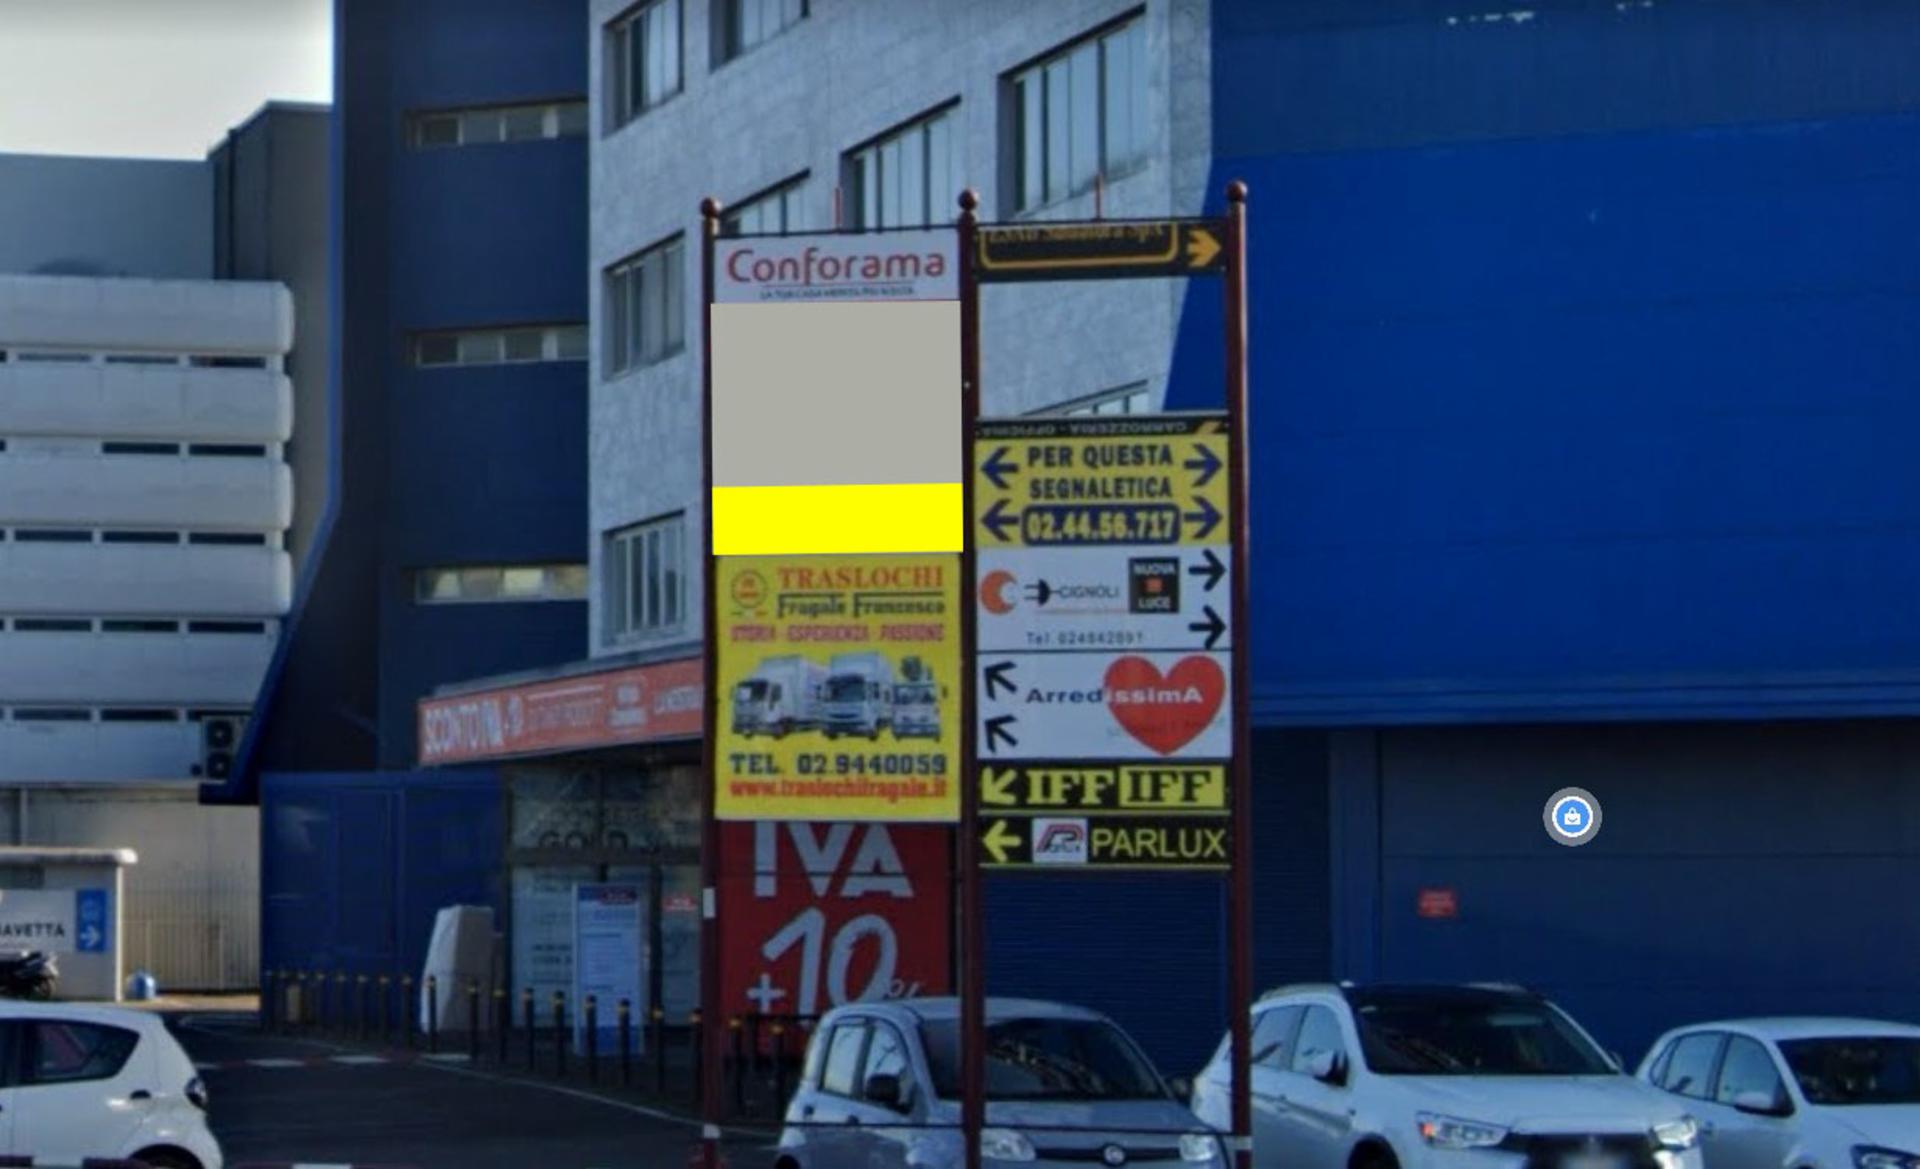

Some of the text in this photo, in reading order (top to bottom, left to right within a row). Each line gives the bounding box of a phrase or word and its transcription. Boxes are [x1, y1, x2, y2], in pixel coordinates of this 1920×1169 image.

[727, 247, 945, 285] Conforama
[1027, 445, 1173, 468] PER QUESTA
[1029, 477, 1173, 499] SEGNALETICA
[778, 567, 943, 589] TRASLOCHI
[1134, 562, 1176, 575] NUOVA
[1060, 585, 1120, 599] CIGNOLI
[1138, 597, 1171, 609] LUCE
[777, 591, 945, 618] Fragale Francesco
[1026, 687, 1203, 704] ArredissimA
[1026, 769, 1212, 804] IFF IFF
[1092, 828, 1226, 859] PARLUX
[754, 822, 915, 897] IVA
[0, 922, 65, 937] AVETTA
